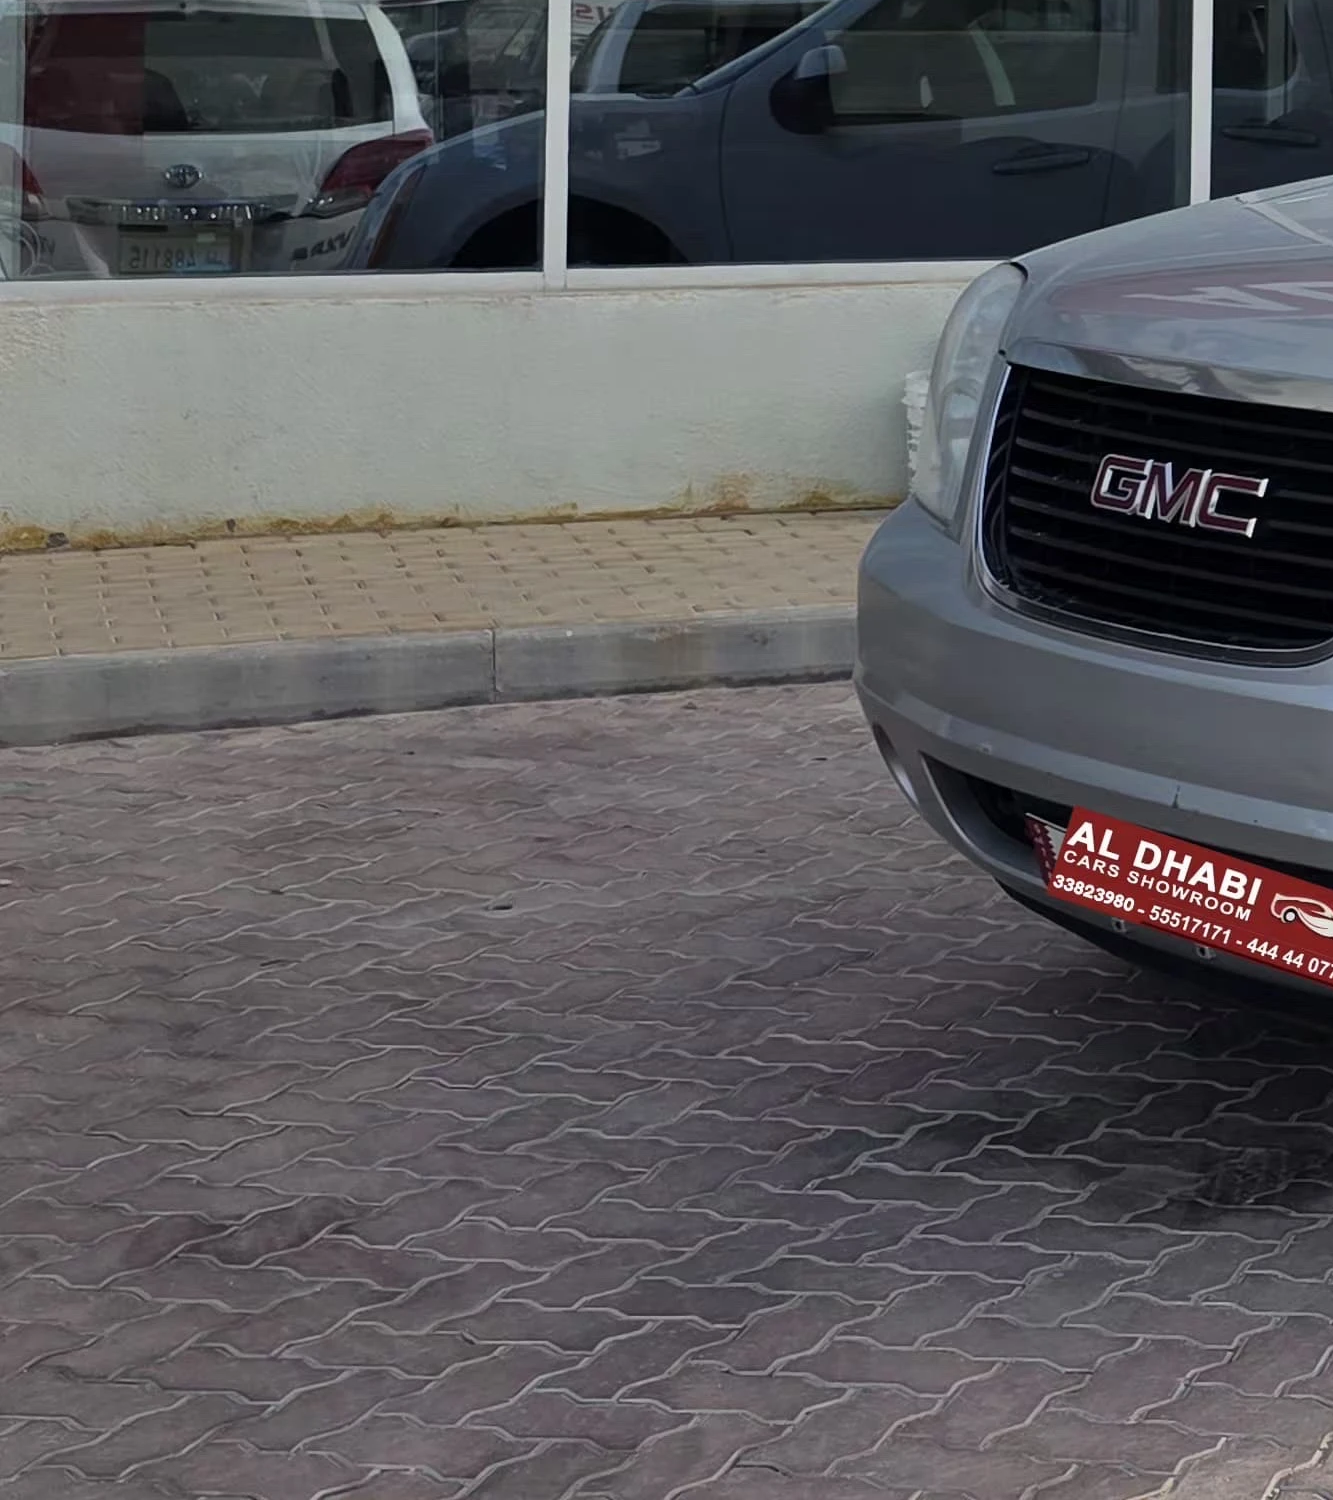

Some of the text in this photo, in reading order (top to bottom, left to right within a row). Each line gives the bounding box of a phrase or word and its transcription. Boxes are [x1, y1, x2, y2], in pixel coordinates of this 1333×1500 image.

[1091, 453, 1269, 538] GMC
[1064, 850, 1120, 878] CARS
[1126, 870, 1252, 921] SHOWROOM
[1067, 821, 1120, 861] AL
[1133, 840, 1263, 906] DHABI
[1053, 874, 1135, 913] 33823980
[1148, 905, 1232, 946] 55517171
[1246, 938, 1279, 960] 444
[1282, 949, 1304, 969] 44
